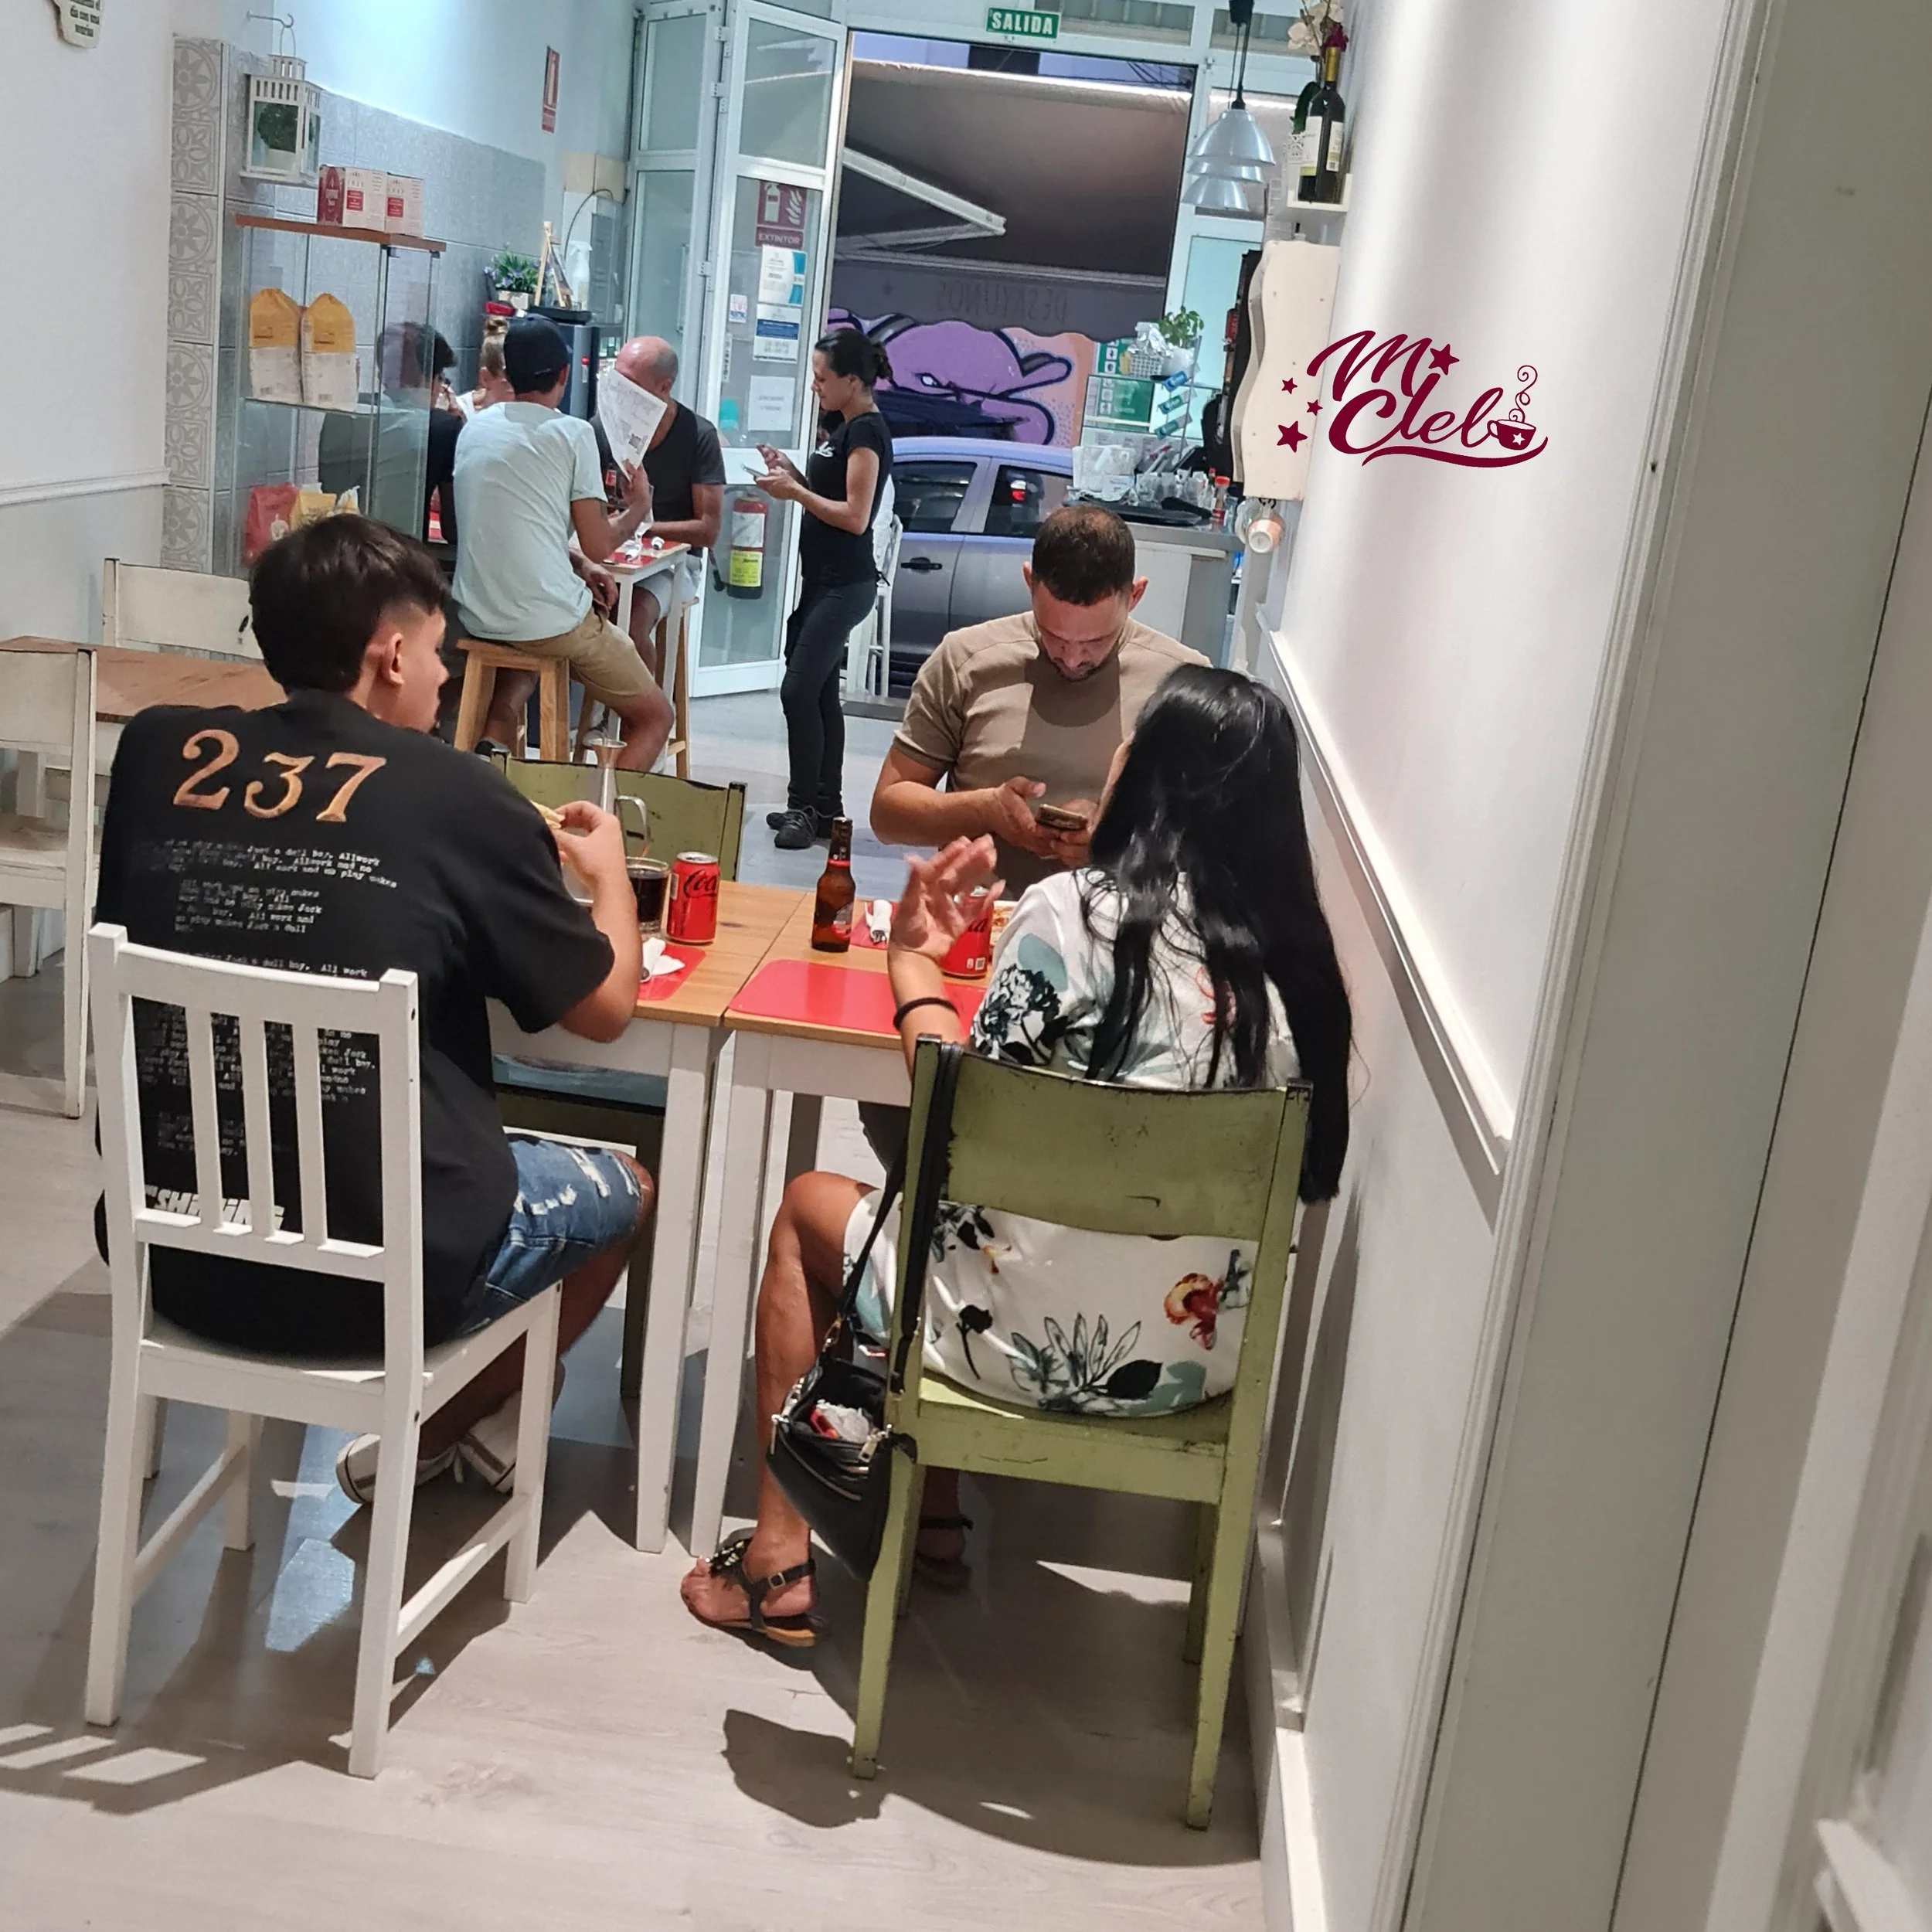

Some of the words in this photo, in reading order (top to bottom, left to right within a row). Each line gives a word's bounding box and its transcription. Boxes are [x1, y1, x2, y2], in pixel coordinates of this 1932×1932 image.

[992, 12, 1053, 35] SALIDA
[758, 233, 801, 244] EXTINTOR
[173, 729, 386, 823] 237
